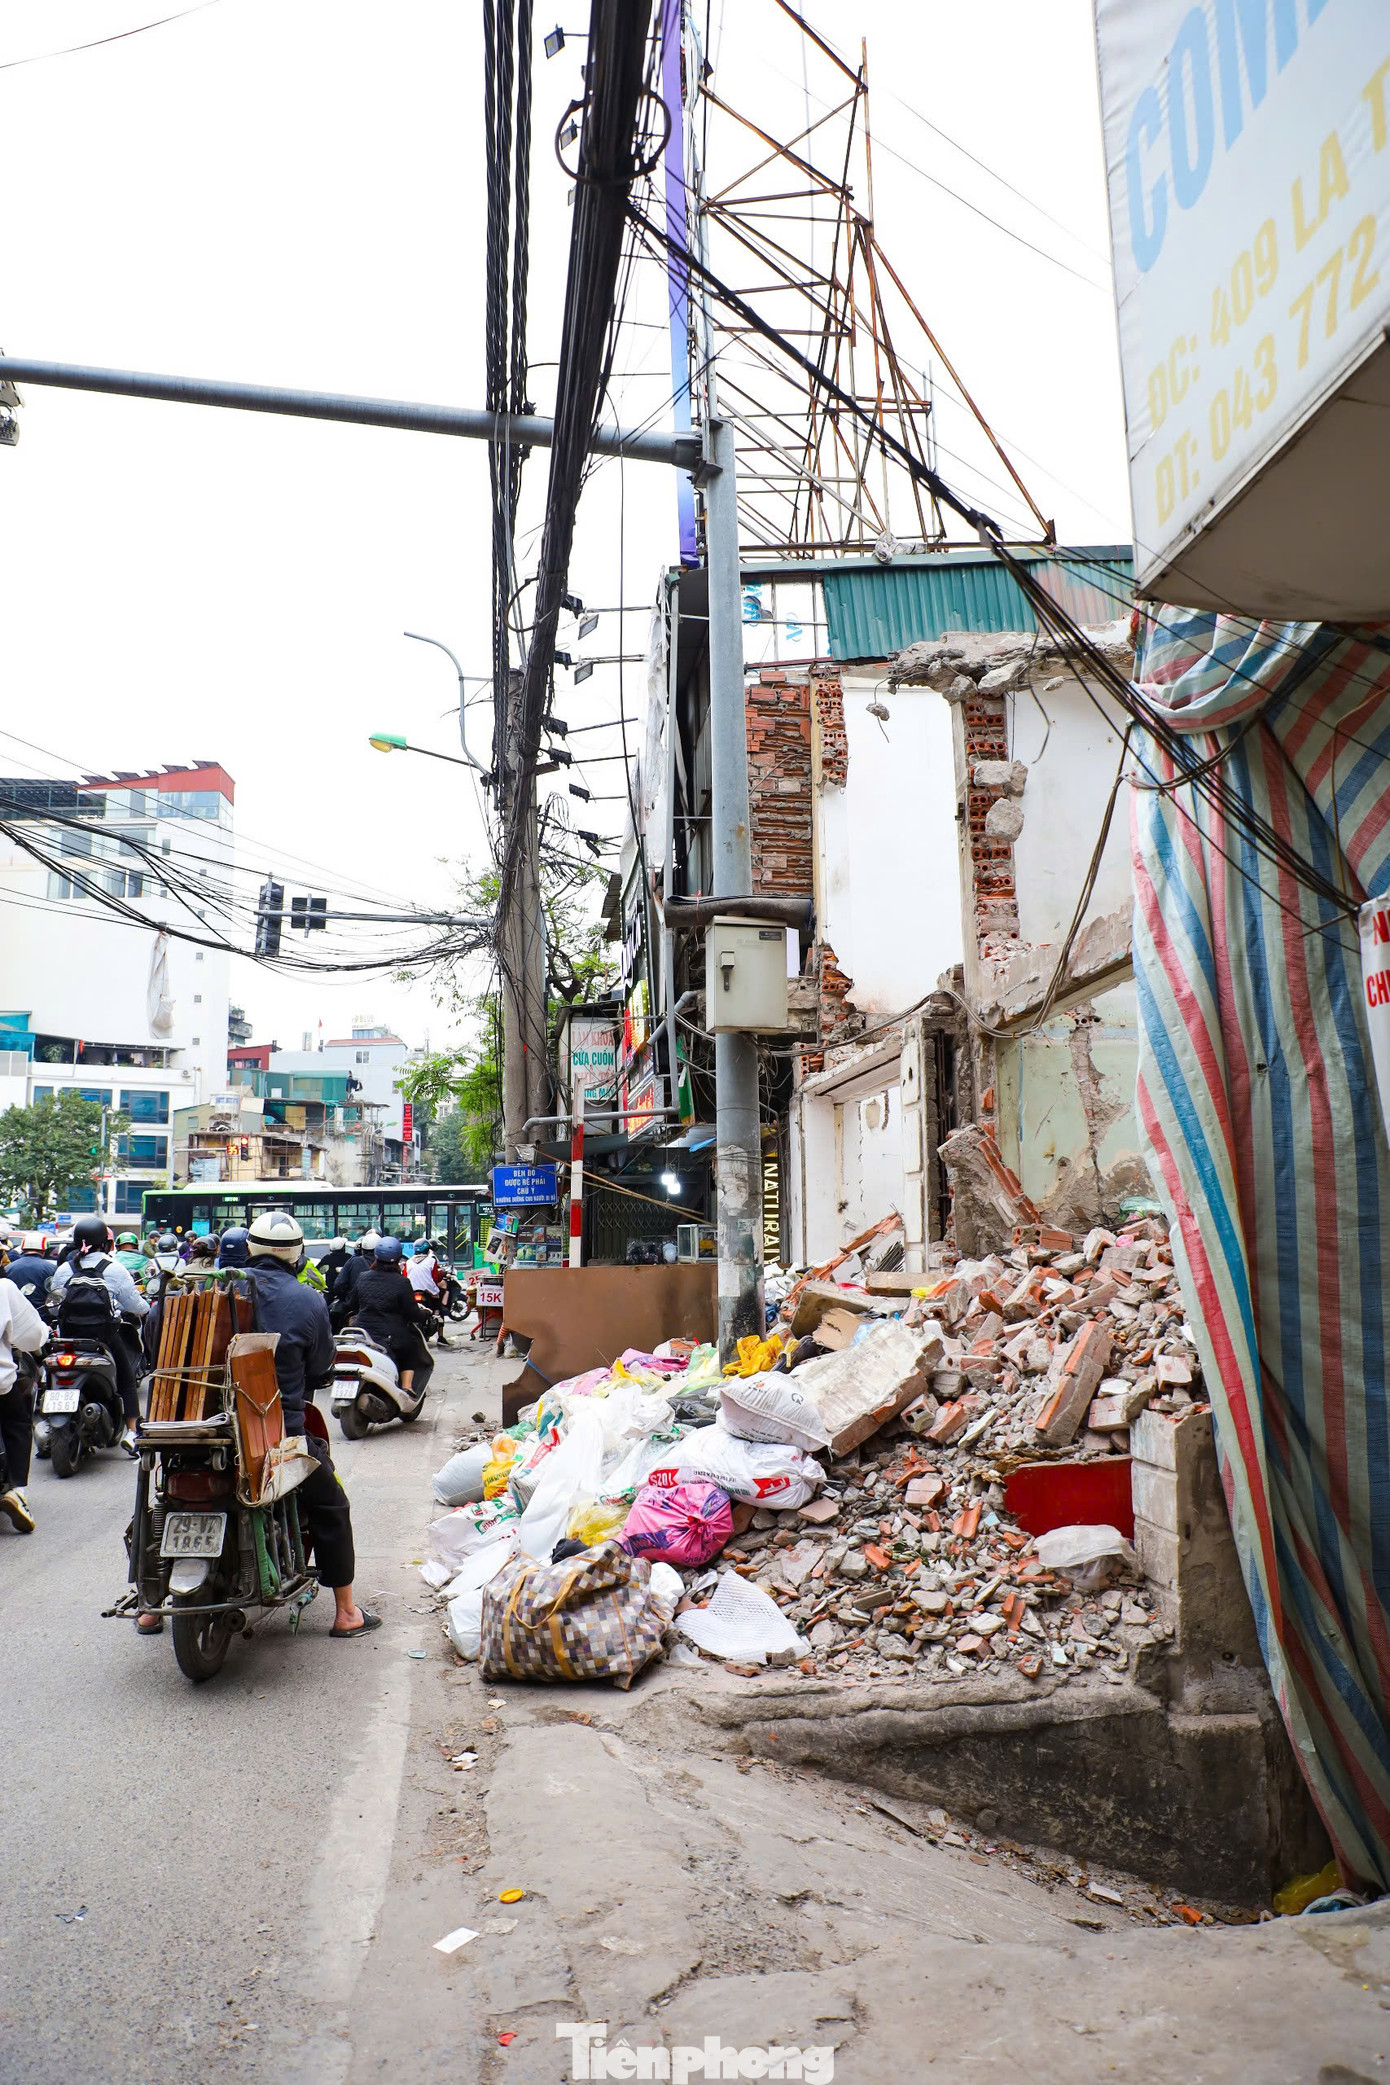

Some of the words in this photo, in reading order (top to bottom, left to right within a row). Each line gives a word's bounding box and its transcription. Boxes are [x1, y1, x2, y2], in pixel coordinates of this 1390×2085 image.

[1210, 217, 1279, 353] 409
[1292, 130, 1350, 254] LA
[1155, 438, 1199, 528] ĐT:
[1210, 331, 1278, 463] 043
[1289, 213, 1381, 371] 772
[1373, 909, 1390, 946] N
[591, 1047, 614, 1066] CUỐN
[480, 1292, 502, 1303] 15K
